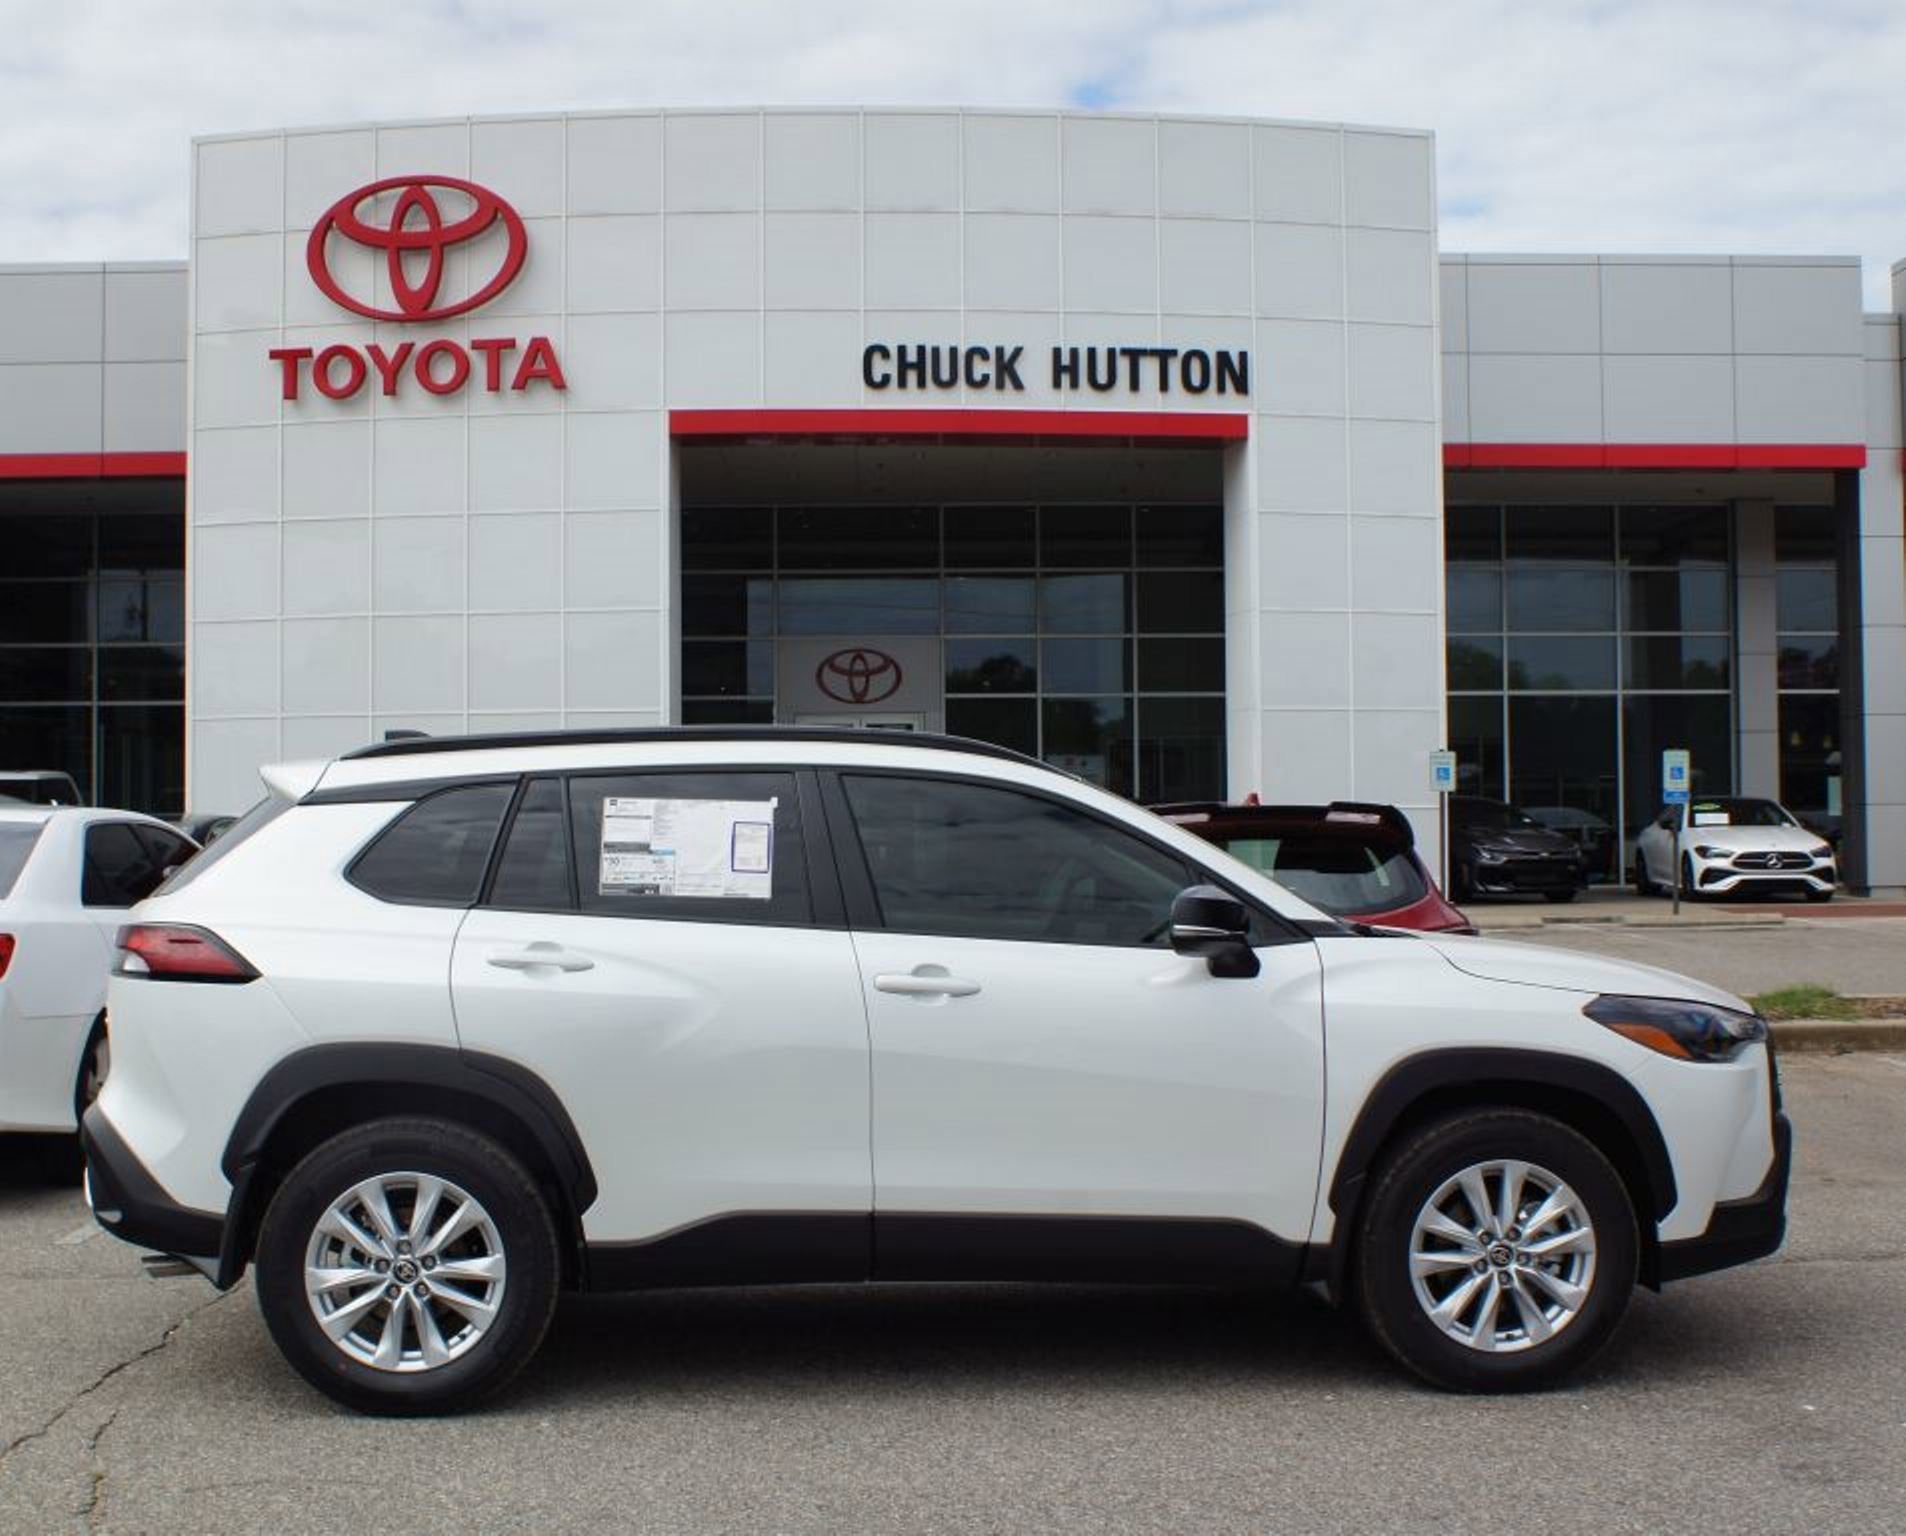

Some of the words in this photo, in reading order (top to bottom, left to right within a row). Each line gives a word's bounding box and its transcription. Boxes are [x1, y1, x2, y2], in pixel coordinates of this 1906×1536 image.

[269, 337, 567, 400] TOYOTA
[862, 344, 1025, 391] CHUCK
[1052, 346, 1249, 396] HUTTON
